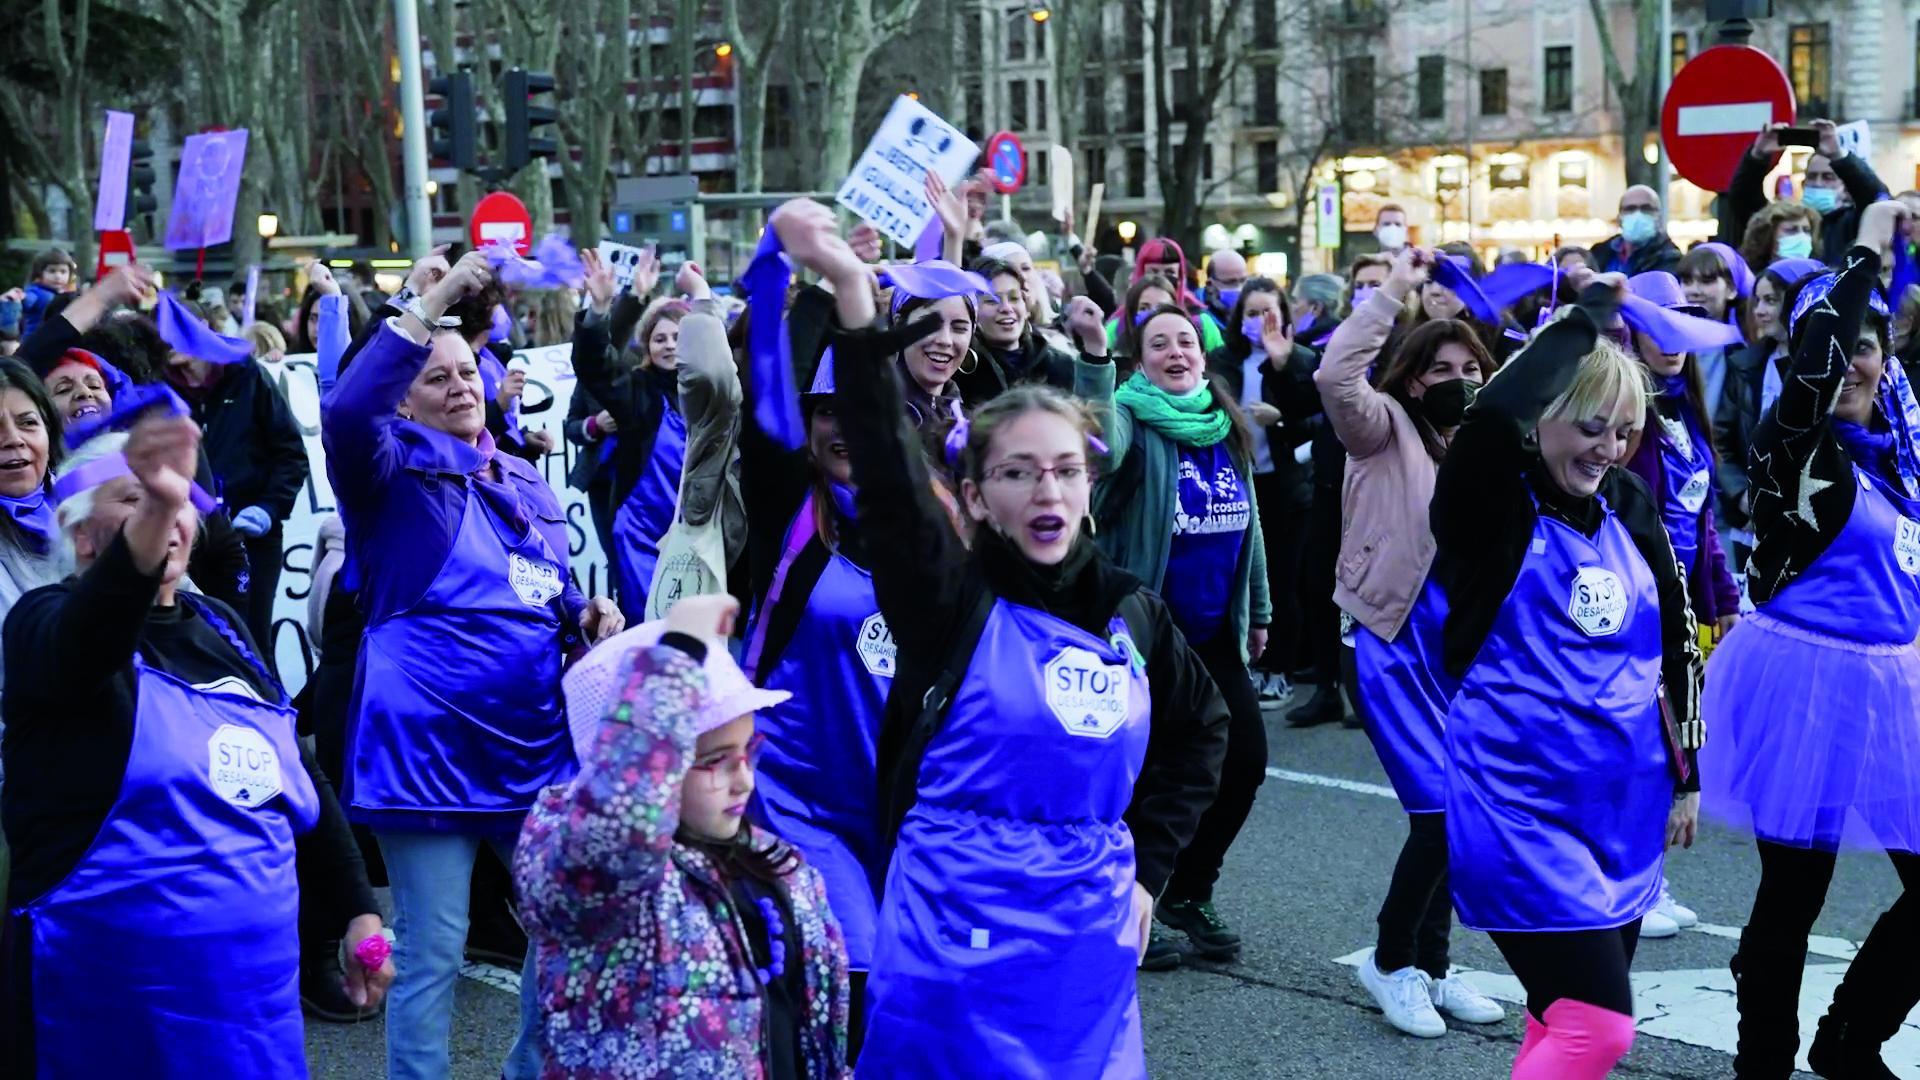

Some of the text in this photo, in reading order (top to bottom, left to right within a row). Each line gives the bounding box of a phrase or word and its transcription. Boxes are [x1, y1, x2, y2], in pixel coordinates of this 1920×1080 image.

[843, 187, 912, 239] AMISTAD
[1902, 521, 1920, 544] ST
[1057, 666, 1122, 695] STOP
[218, 742, 272, 772] STOP
